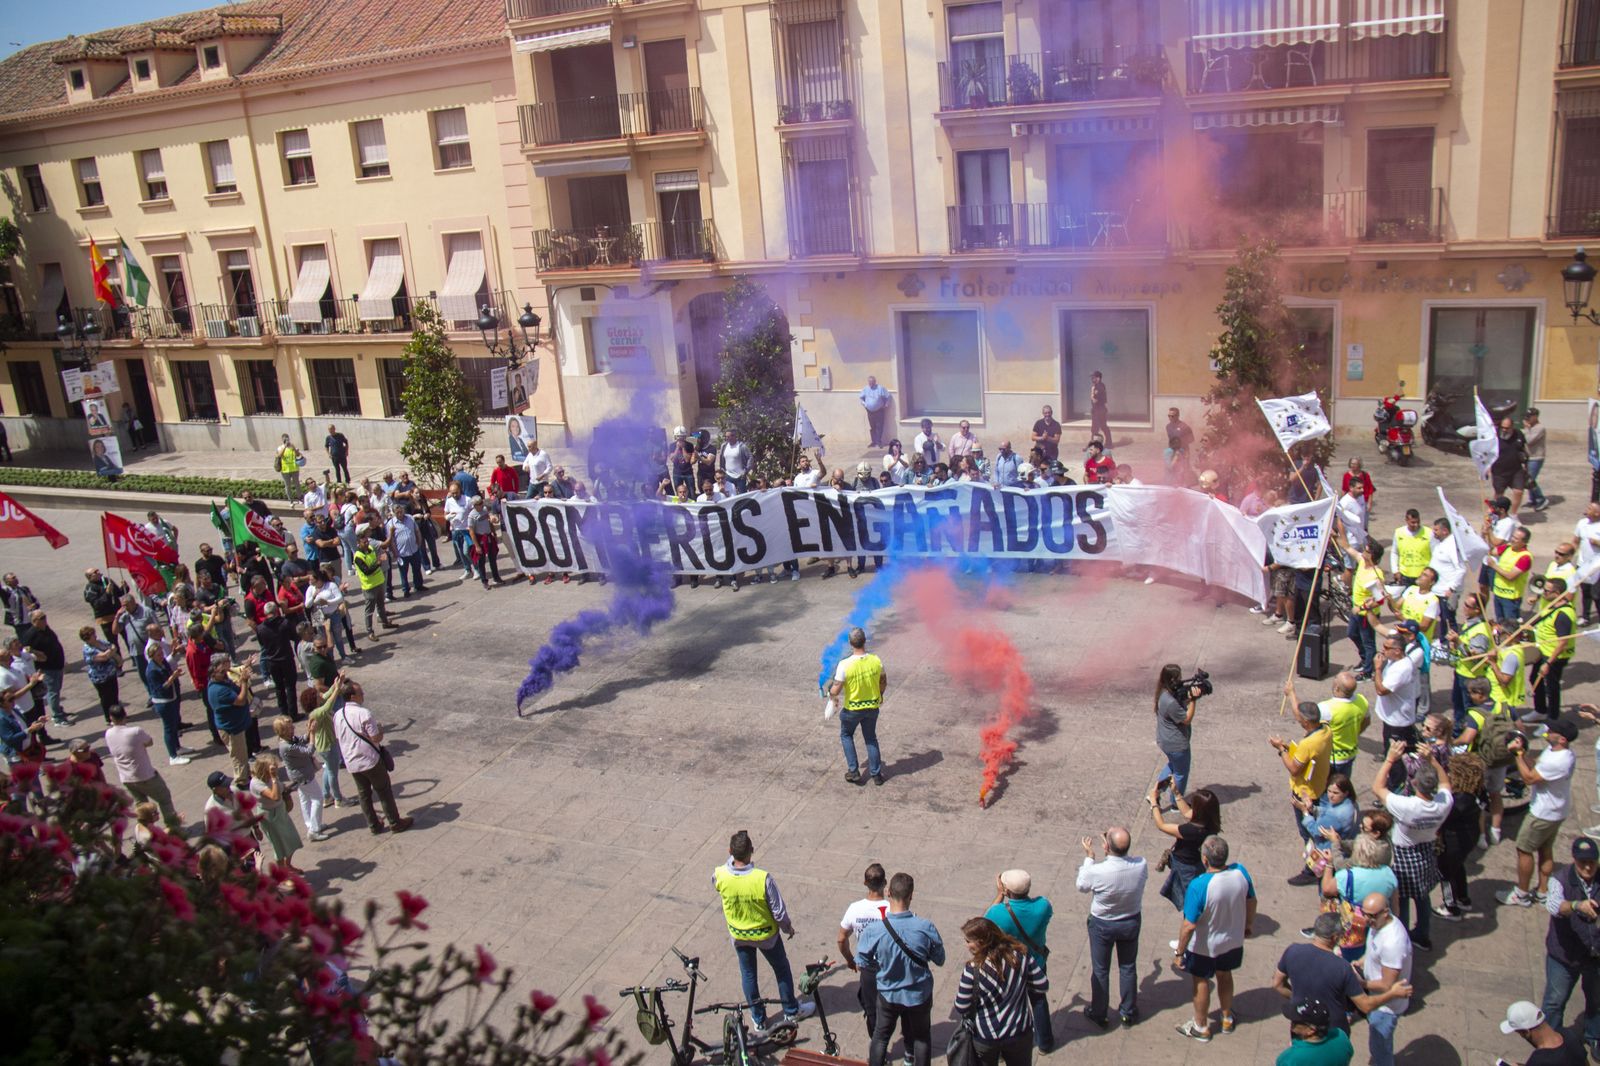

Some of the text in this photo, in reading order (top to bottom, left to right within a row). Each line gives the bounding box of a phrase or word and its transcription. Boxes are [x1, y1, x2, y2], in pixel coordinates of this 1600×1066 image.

[940, 273, 1073, 297] Fraternidad
[506, 487, 1107, 571] BOMBEROS ENGAÑADOS
